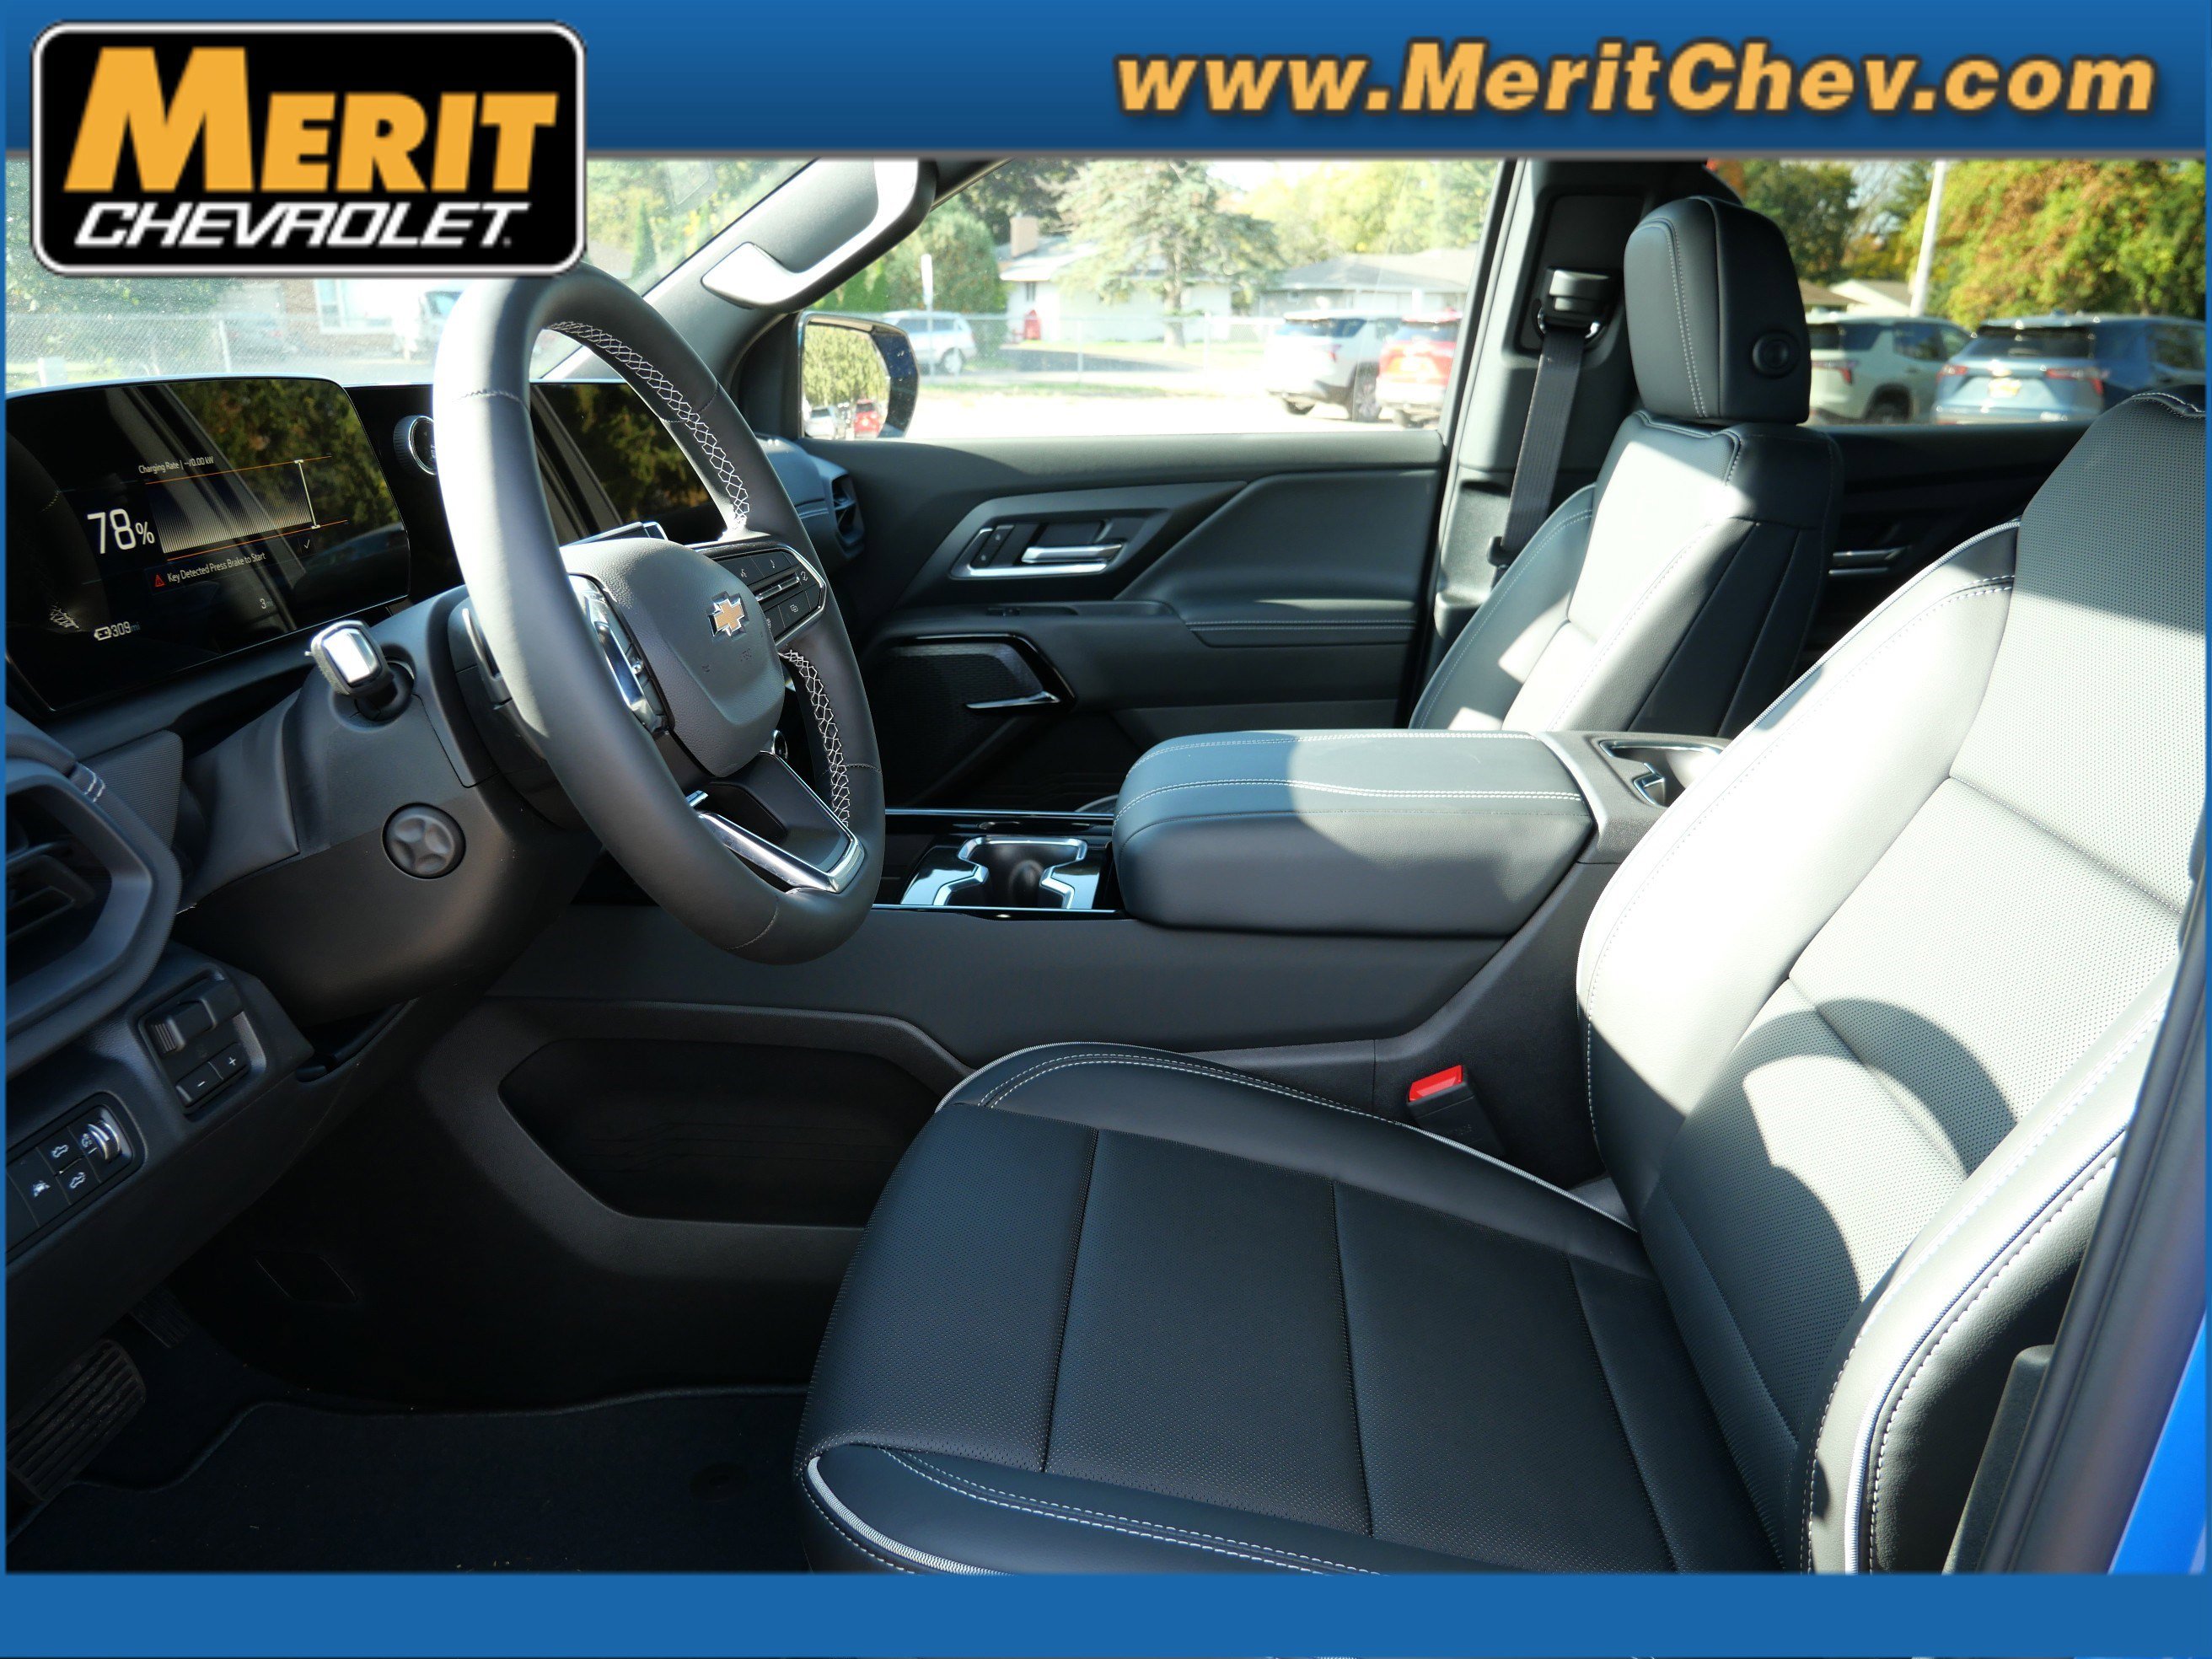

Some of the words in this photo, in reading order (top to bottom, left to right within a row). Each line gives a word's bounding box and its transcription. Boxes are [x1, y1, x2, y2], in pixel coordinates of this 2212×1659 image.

[138, 464, 166, 474] Charging
[165, 460, 180, 470] Rate
[168, 572, 180, 583] Key
[180, 563, 210, 579] Detected
[210, 561, 228, 572] Press
[227, 558, 245, 568] Brake
[244, 556, 252, 564] to
[251, 552, 266, 562] Start
